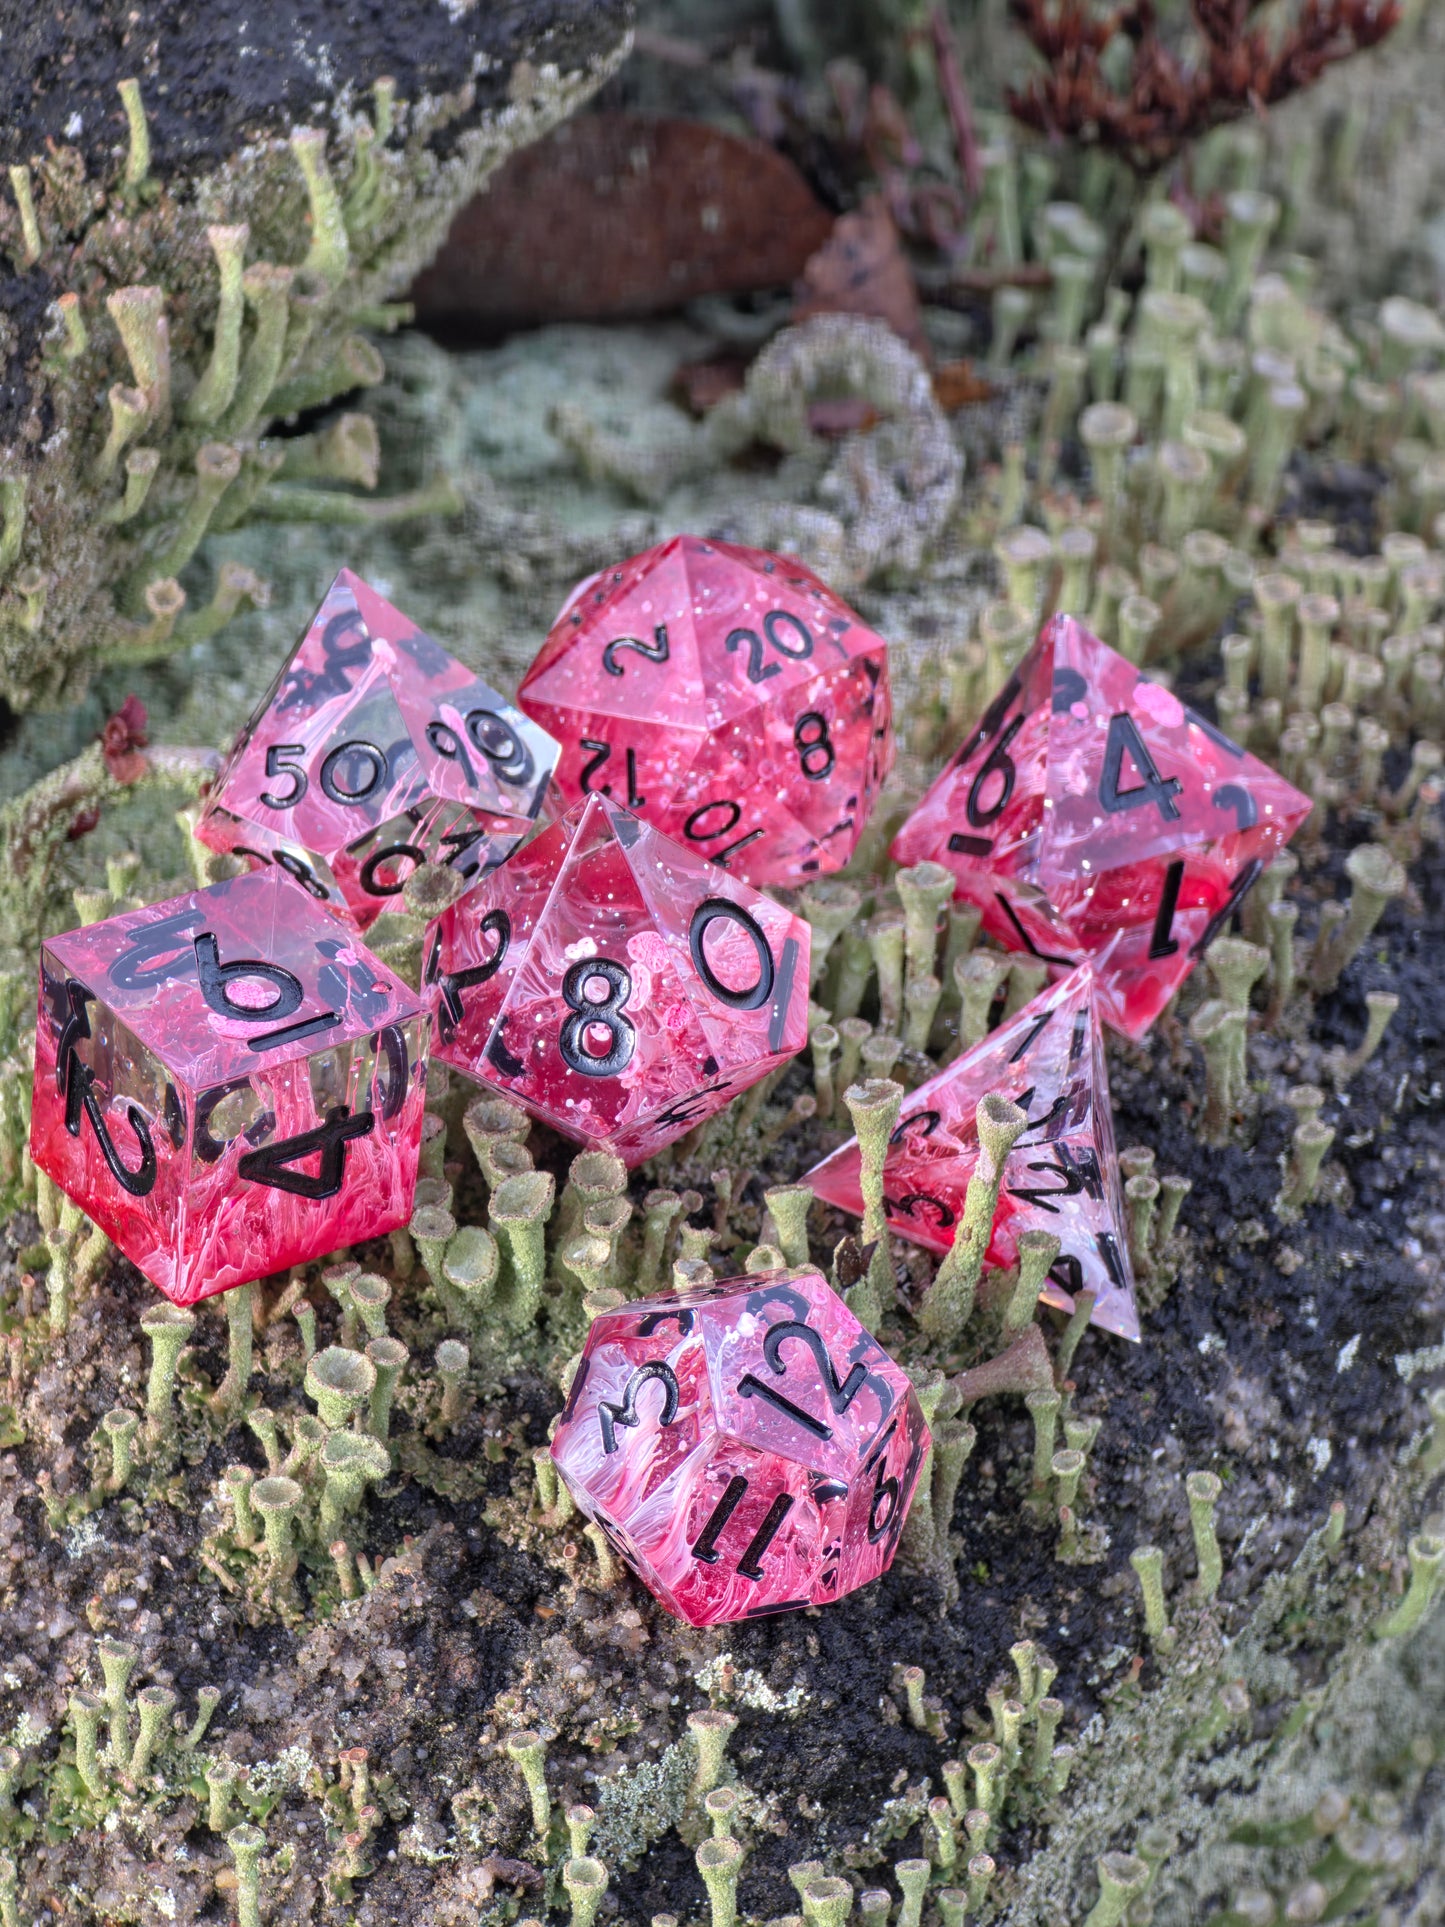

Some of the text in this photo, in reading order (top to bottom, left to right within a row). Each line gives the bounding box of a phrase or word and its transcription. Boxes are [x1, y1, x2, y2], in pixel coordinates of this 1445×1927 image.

[603, 623, 670, 676] 2
[725, 610, 814, 684] 20
[260, 739, 389, 810] 50
[425, 709, 527, 790] 90
[795, 712, 835, 781] 8
[966, 713, 1016, 828] 6
[1100, 711, 1184, 823] 4
[684, 800, 766, 868] 10
[193, 931, 305, 1023] 6
[689, 898, 775, 1011] 0
[559, 957, 636, 1077] 8
[238, 1105, 376, 1200] 4
[600, 1360, 680, 1455] 3
[736, 1319, 869, 1442] 12
[691, 1475, 795, 1582] 11
